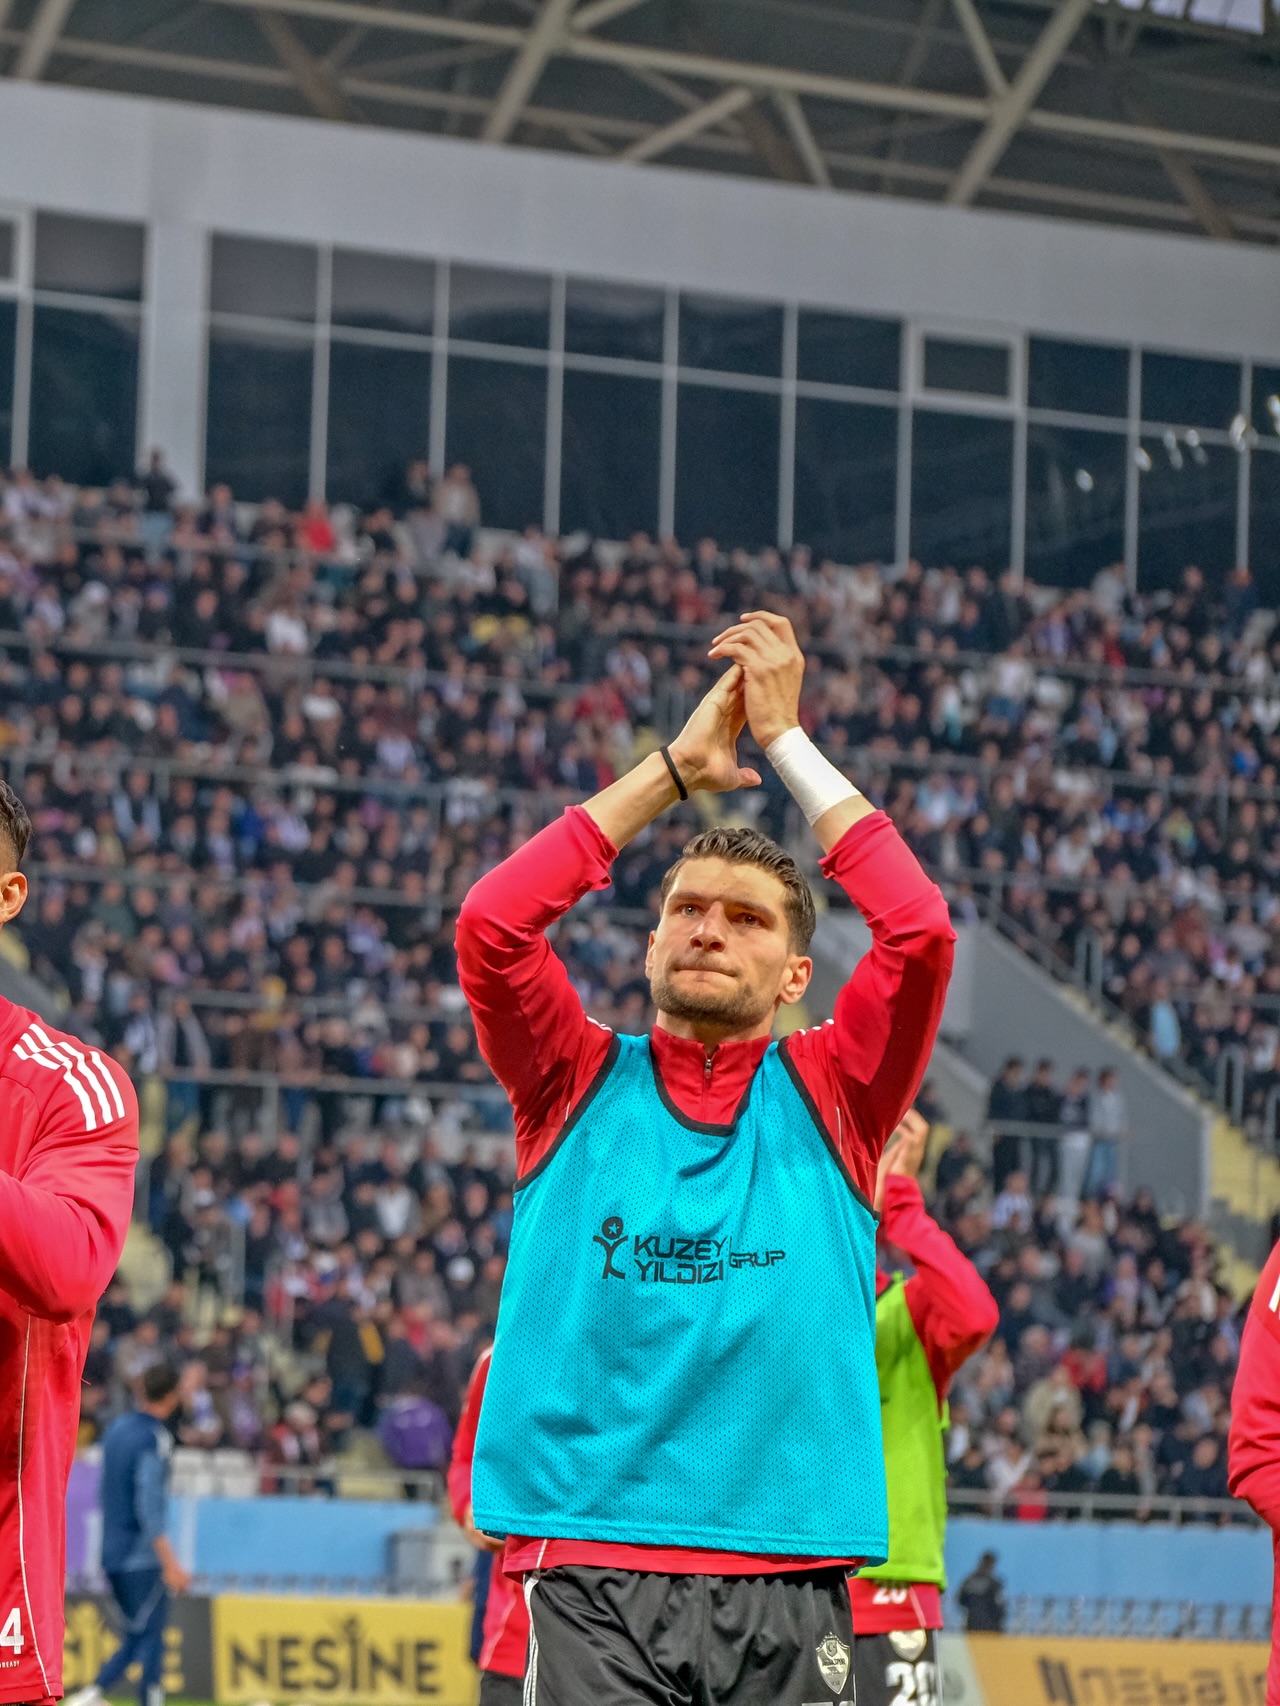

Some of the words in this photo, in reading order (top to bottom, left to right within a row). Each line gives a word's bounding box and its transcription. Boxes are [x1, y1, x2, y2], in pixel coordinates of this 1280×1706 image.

[633, 1235, 728, 1261] KUZEY
[728, 1249, 787, 1269] GRUP
[634, 1259, 724, 1285] YILDIZI
